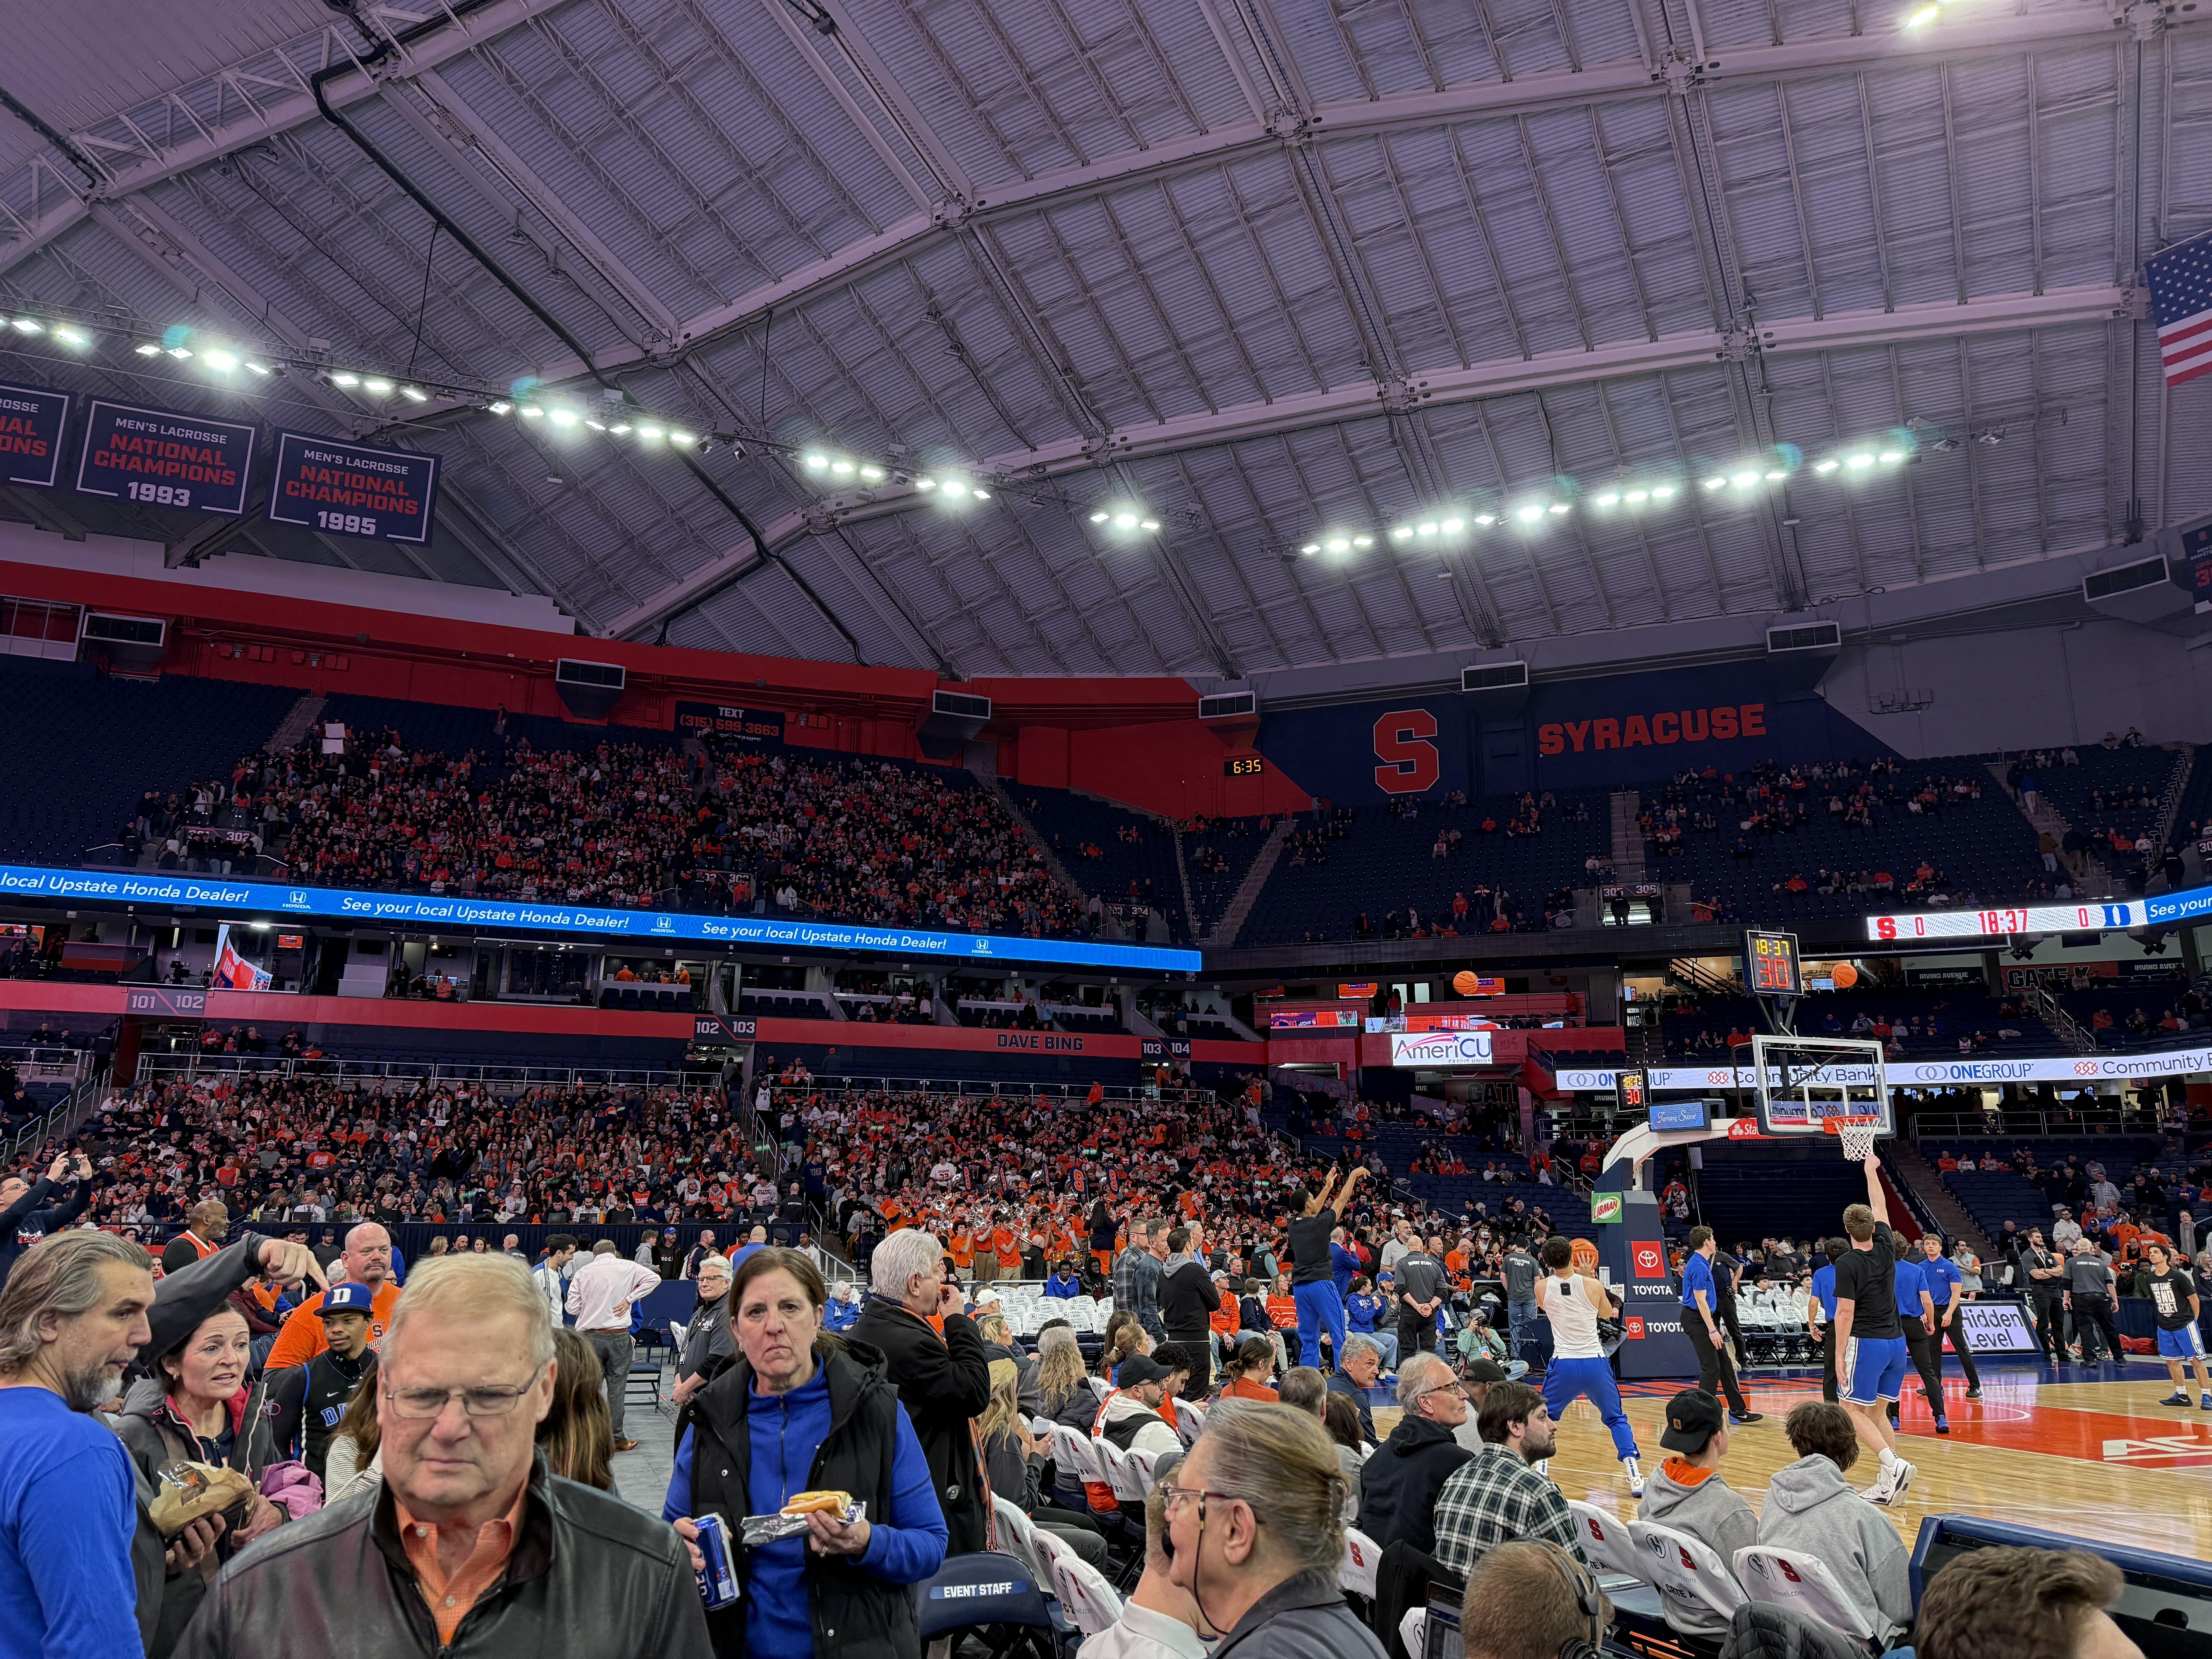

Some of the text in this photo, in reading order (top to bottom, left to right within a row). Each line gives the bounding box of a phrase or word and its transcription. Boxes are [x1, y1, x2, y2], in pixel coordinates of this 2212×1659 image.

[115, 417, 227, 444] MEN'S LACROSSE
[110, 433, 226, 466] NATIONAL
[94, 450, 235, 485] CHAMPIONS
[304, 450, 409, 475] MEN'S LACROSSE
[300, 465, 409, 496] NATIONAL
[127, 481, 190, 507] 1993
[285, 481, 417, 514] CHAMPIONS
[317, 511, 376, 535] 1995
[718, 707, 744, 718] TEXT
[680, 714, 713, 728] (315)
[716, 719, 779, 736] 599-3663
[1539, 703, 1766, 754] SYRACUSE
[1373, 709, 1440, 794] S
[1233, 759, 1261, 773] 6:35
[0, 871, 250, 903] local Upstate Honda Dealer!
[342, 897, 629, 929] See your local Upstate Honda Dealer!
[2150, 902, 2175, 917] See
[1877, 917, 1896, 939] S
[1915, 917, 1924, 936] 0
[1978, 910, 2027, 934] 18:37
[2078, 908, 2089, 927] 0
[702, 922, 946, 950] See your local Upstate Honda Dealer!
[1756, 939, 1790, 956] 18:37
[1758, 957, 1790, 987] 30
[132, 995, 204, 1009] 101 102
[696, 1021, 755, 1034] 102 103
[997, 1033, 1084, 1051] DAVE BING
[1142, 1042, 1190, 1054] 103 104
[1394, 1038, 1491, 1059] AmeriCU
[1836, 1068, 1877, 1081] Bank
[1950, 1063, 2032, 1079] ONEGROUP
[2102, 1054, 2203, 1074] Community
[1627, 1089, 1640, 1104] 30
[1657, 1109, 1696, 1123] Turning Stone
[1593, 1199, 1618, 1221] LIBMAN
[331, 1288, 351, 1304] D
[1633, 1285, 1673, 1295] TOYOTA
[1962, 1309, 2024, 1328] Hidden
[371, 1324, 383, 1338] S
[1963, 1329, 2014, 1348] Level
[1588, 1518, 1604, 1541] S
[1350, 1541, 1364, 1568] S
[1679, 1546, 1697, 1570] S
[1778, 1558, 1802, 1583] S
[944, 1582, 1012, 1599] EVENT STAFF
